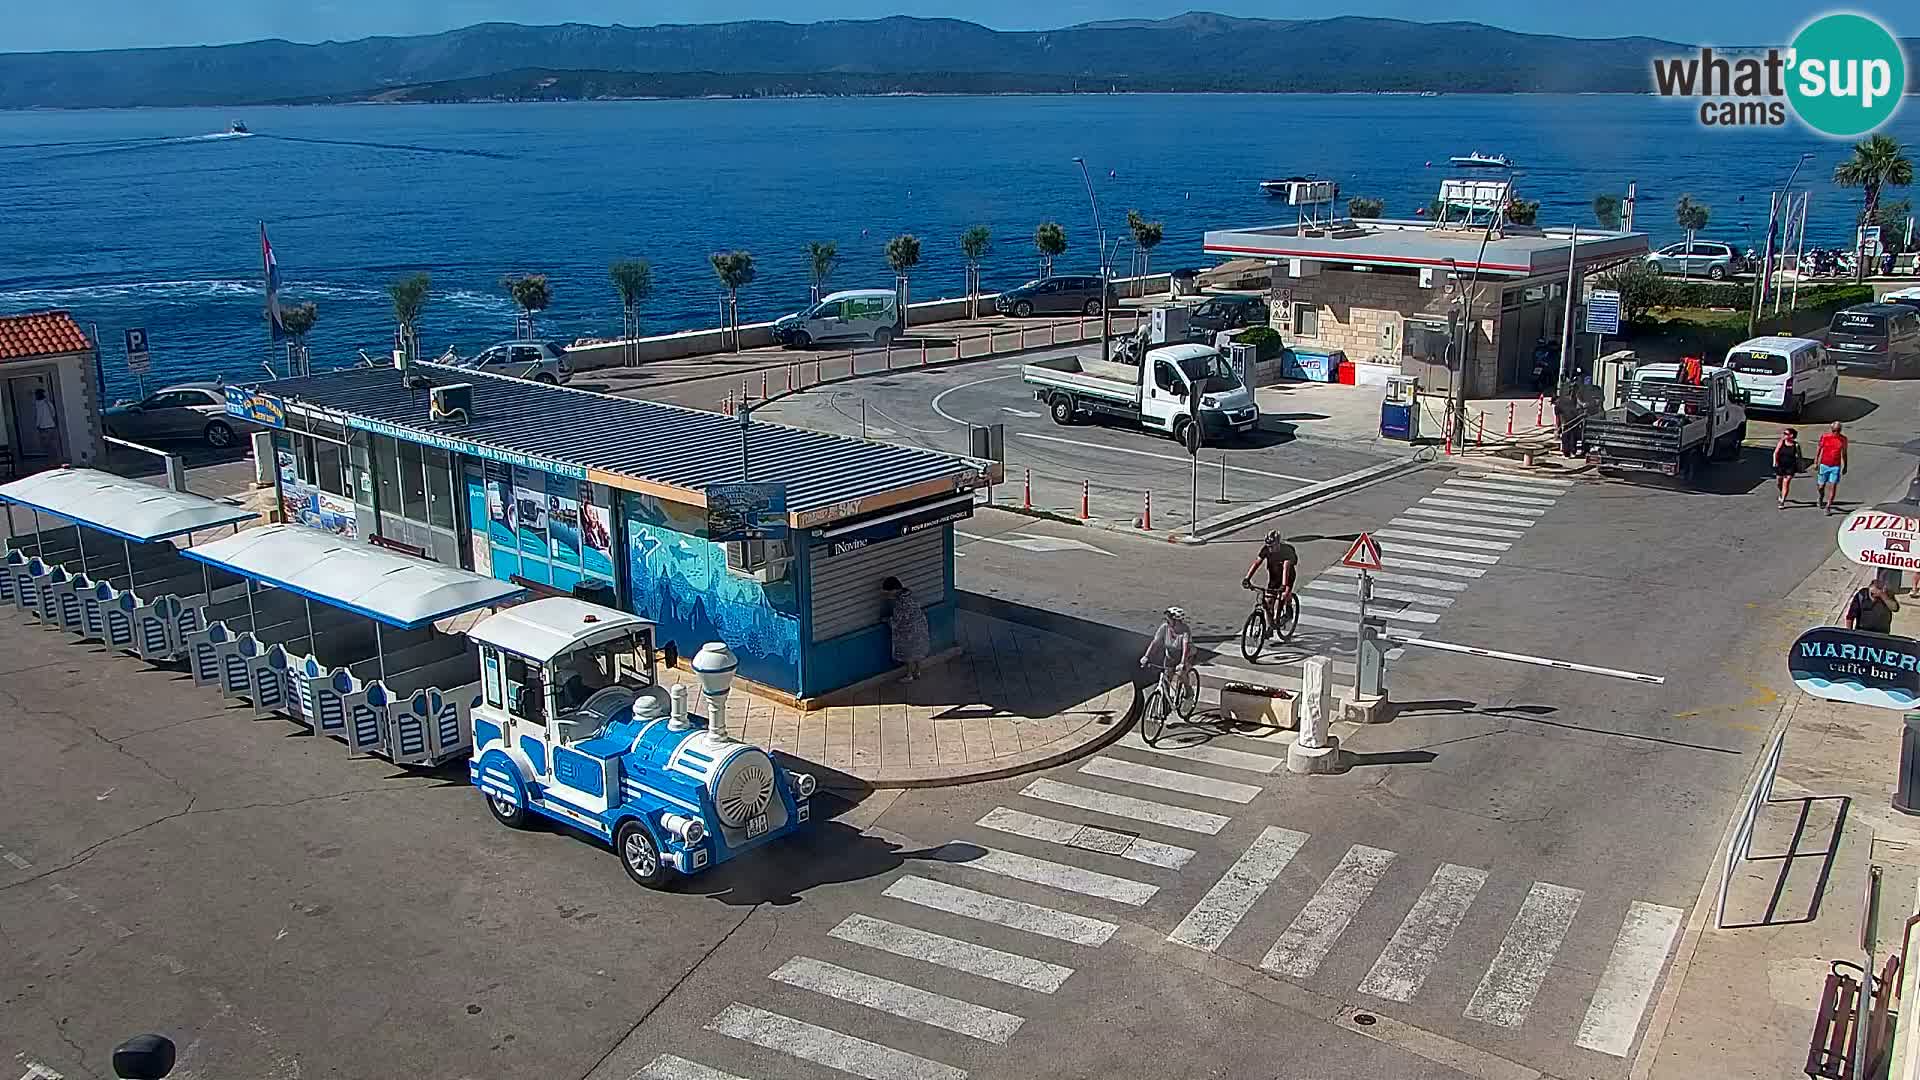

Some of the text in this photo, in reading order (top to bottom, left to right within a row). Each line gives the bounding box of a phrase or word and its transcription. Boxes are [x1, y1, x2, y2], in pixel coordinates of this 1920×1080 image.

[1850, 315, 1869, 323] TAXI
[129, 331, 142, 350] P
[1750, 352, 1768, 360] TAXI
[436, 436, 468, 452] POSTAJA
[477, 447, 493, 459] BUS
[493, 450, 526, 465] STATION
[527, 457, 554, 472] TICKET
[555, 464, 582, 478] OFFICE
[1847, 514, 1920, 534] PIZZE
[1881, 530, 1917, 541] GRILL
[1799, 641, 1920, 674] MARINER
[1829, 662, 1898, 680] caffe bar
